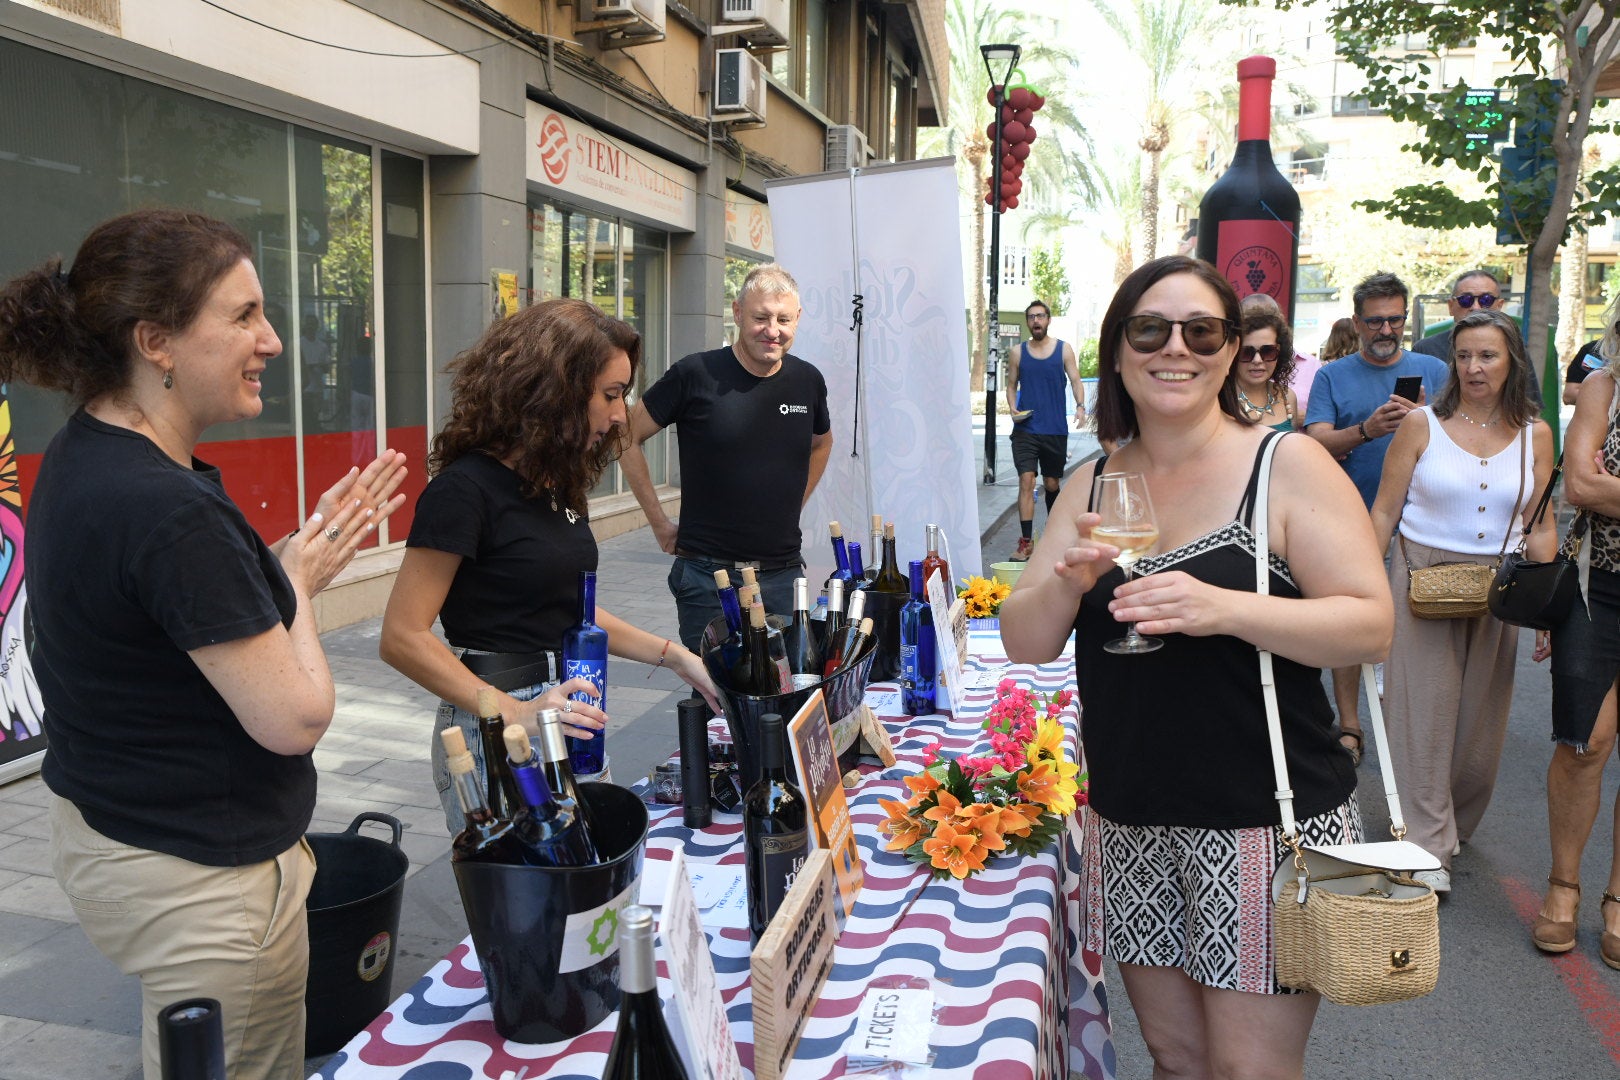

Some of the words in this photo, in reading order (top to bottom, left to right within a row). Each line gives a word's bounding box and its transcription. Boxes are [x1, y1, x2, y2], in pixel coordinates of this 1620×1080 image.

[576, 133, 620, 179] STEM
[1234, 249, 1278, 267] QUINTANA
[786, 880, 824, 970] BODEGAS
[786, 913, 826, 1009] ORTIGOSA
